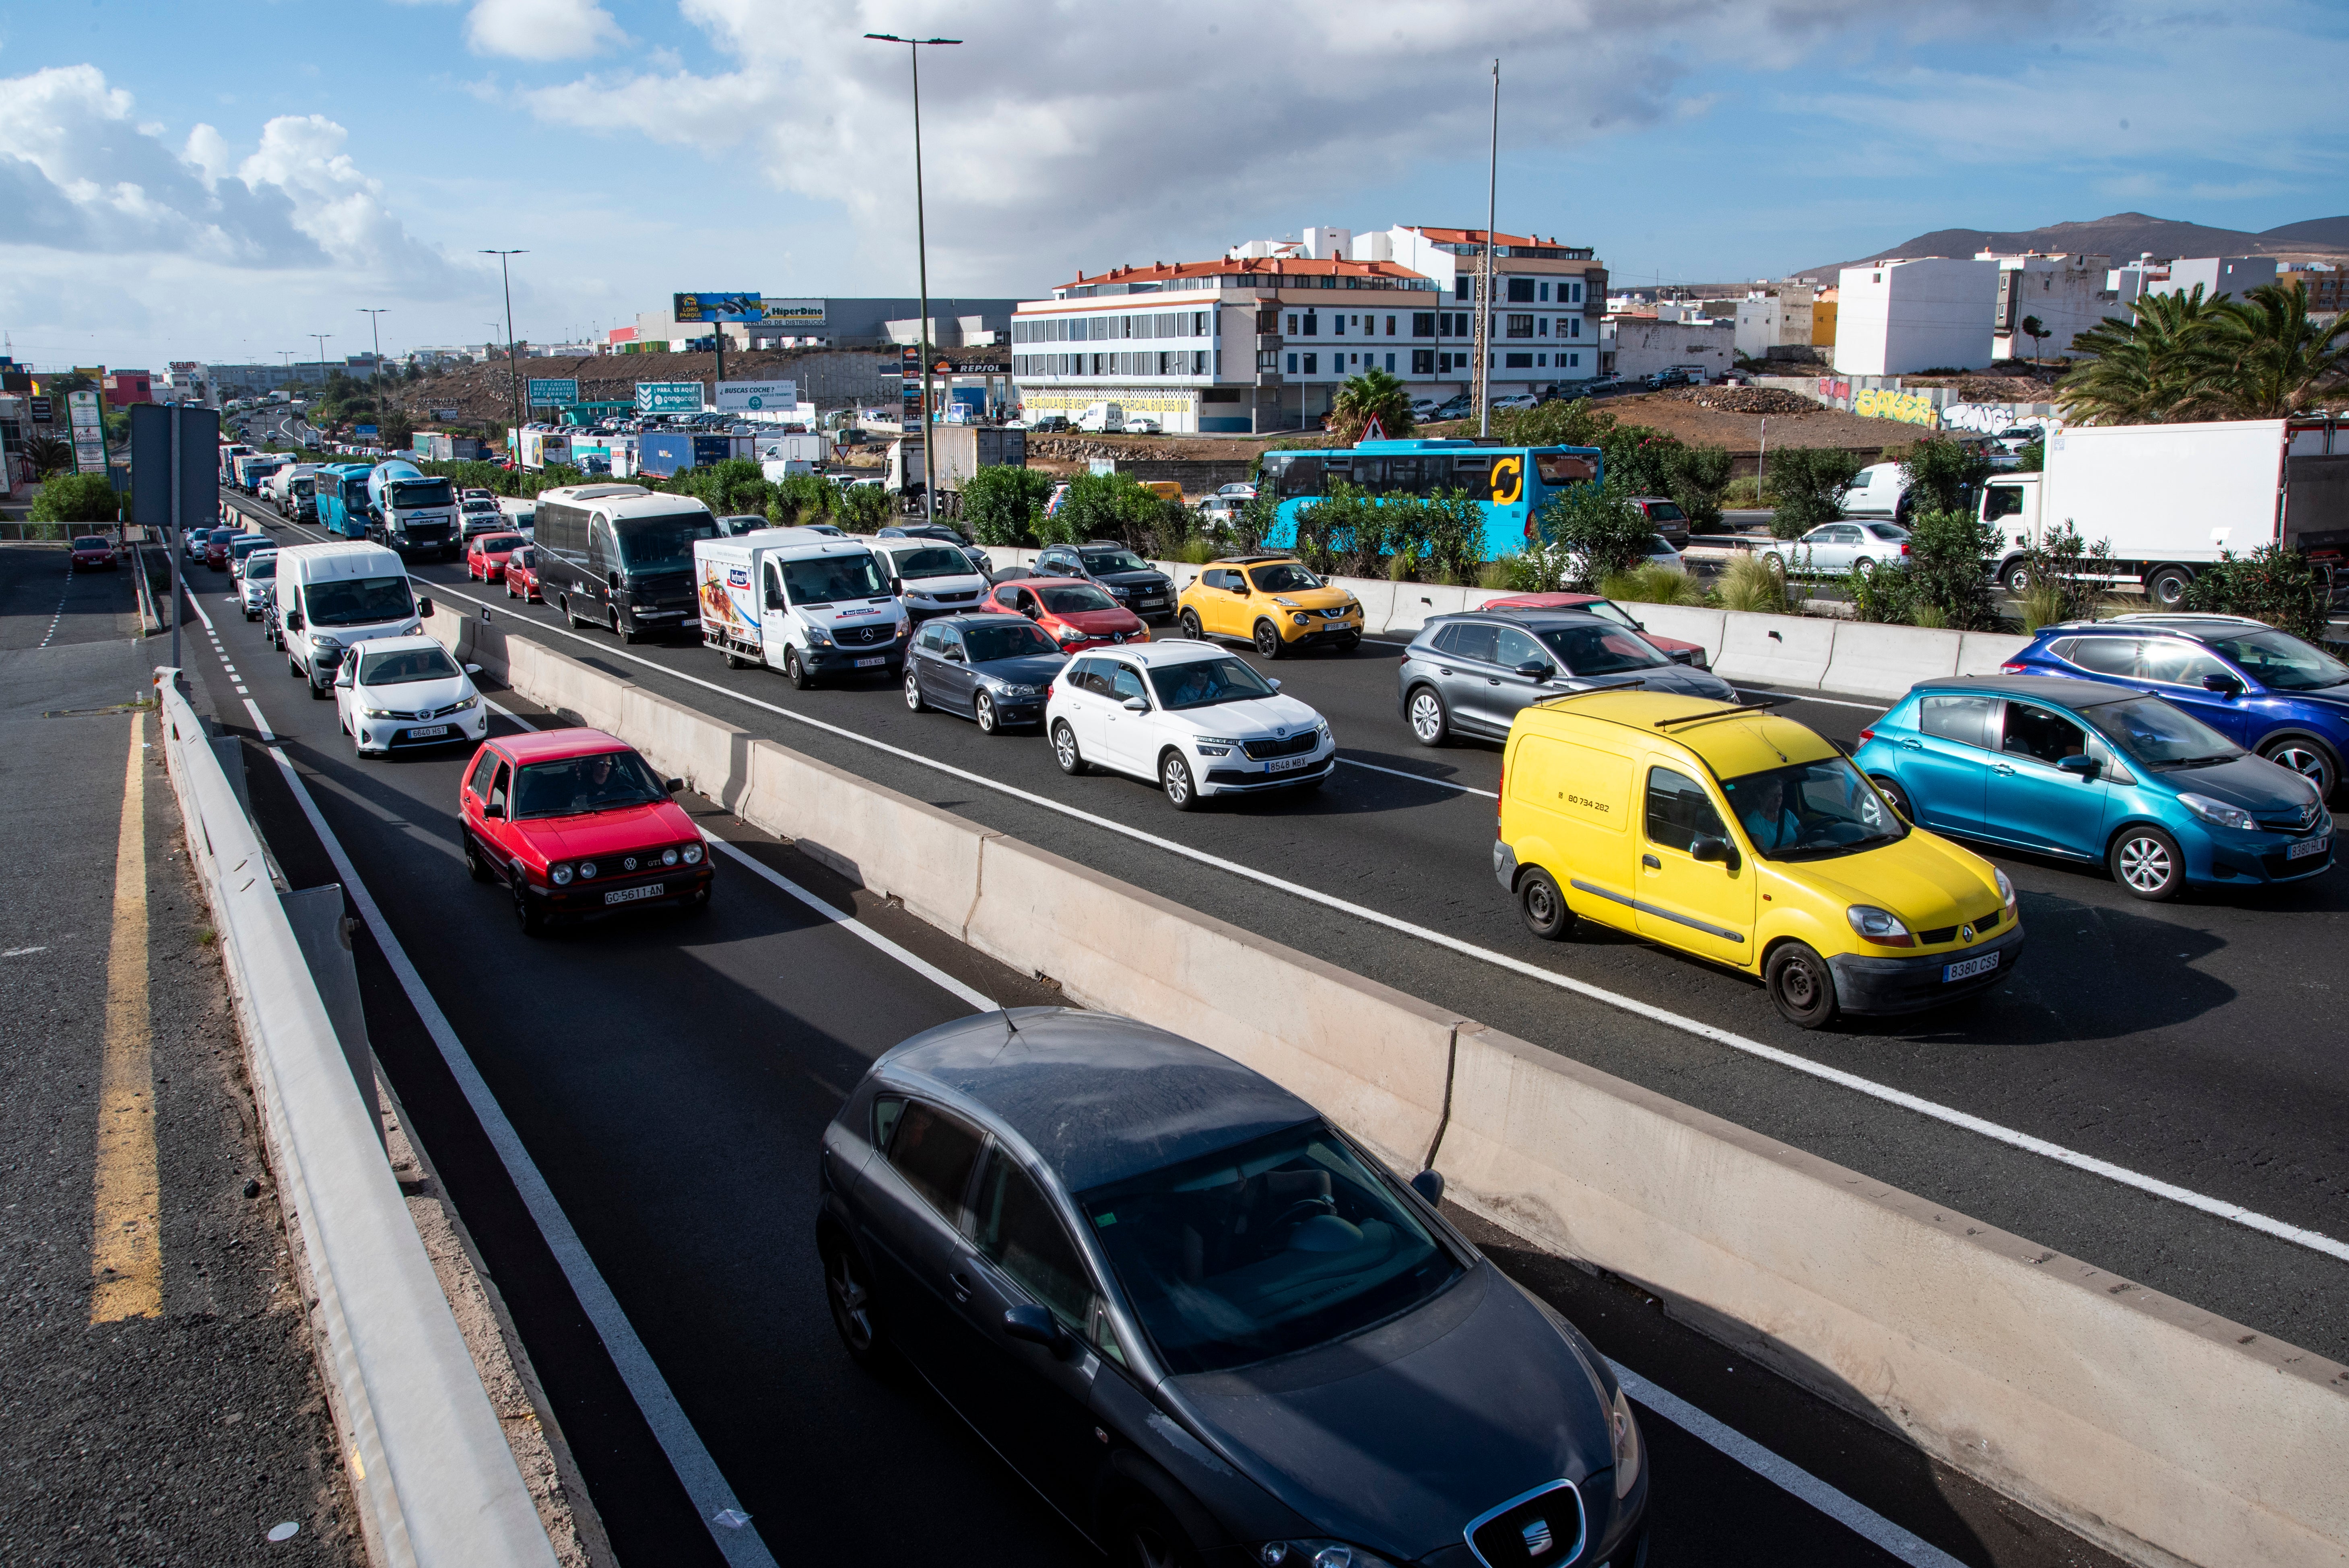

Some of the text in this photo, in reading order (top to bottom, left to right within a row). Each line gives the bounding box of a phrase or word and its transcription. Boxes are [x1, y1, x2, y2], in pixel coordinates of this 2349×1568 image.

[772, 307, 823, 317] HiperDino
[1027, 398, 1033, 409] SE
[1059, 399, 1064, 409] O
[1065, 399, 1072, 409] SE
[1122, 400, 1150, 410] PARCIAL
[1151, 400, 1161, 411] 610
[1164, 400, 1175, 411] 585
[1178, 400, 1188, 411] 100
[731, 571, 745, 584] bofrost
[413, 727, 445, 737] 6640 HST
[1271, 757, 1306, 771] 8548 MBX
[1568, 795, 1609, 812] 80 734 282
[2292, 844, 2309, 857] 8380
[606, 886, 663, 903] GC-5611-AN
[1951, 955, 1996, 978] 8380 CSS
